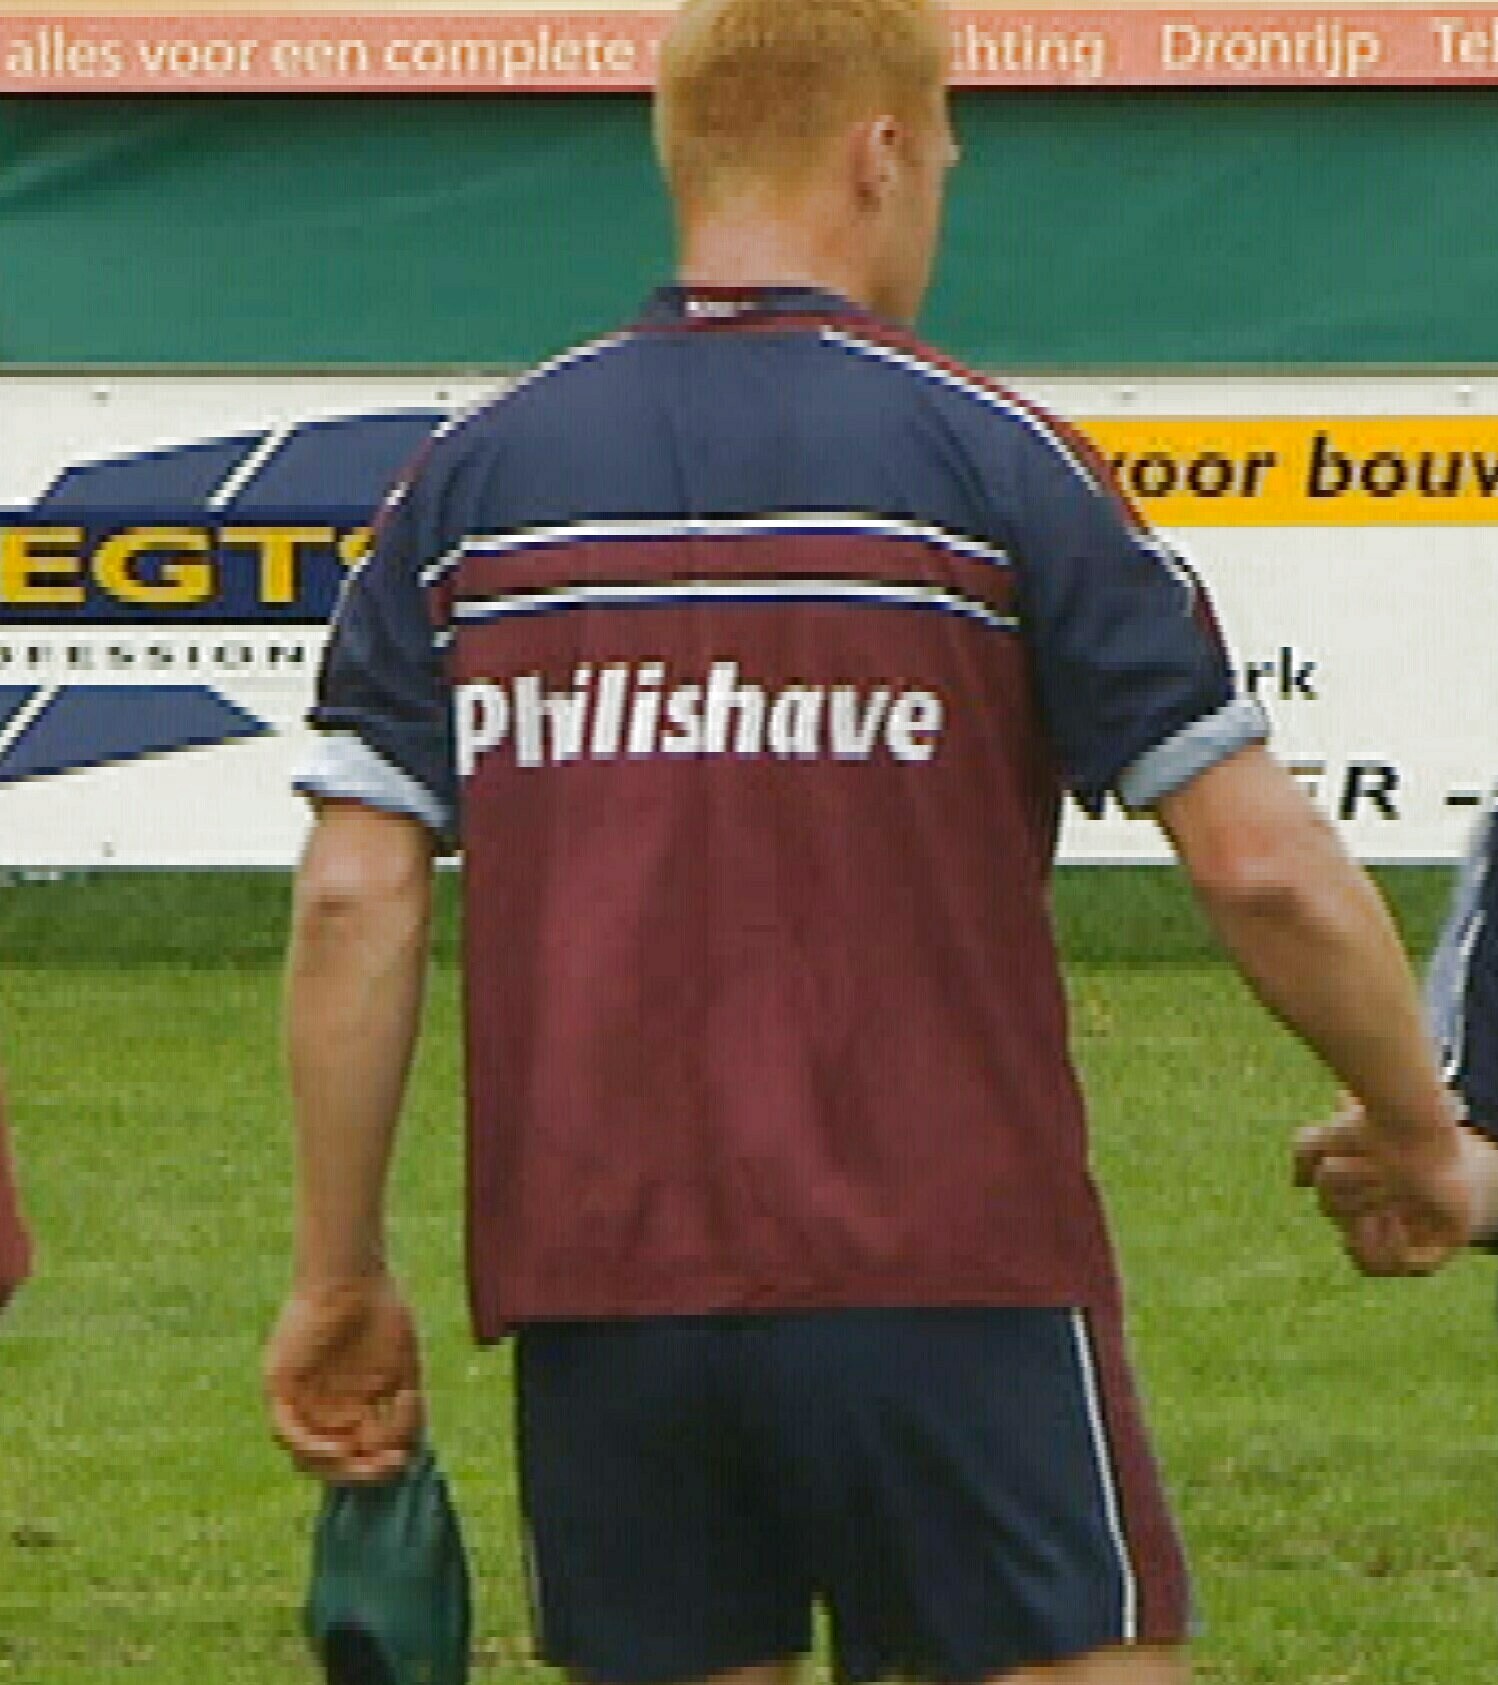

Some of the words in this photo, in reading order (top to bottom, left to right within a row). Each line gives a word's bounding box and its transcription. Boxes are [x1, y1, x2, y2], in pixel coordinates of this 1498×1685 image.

[4, 24, 122, 77] alles
[139, 38, 258, 74] voor
[271, 38, 367, 74] een
[383, 24, 636, 83] complete
[1160, 22, 1382, 78] Dronrijp
[1245, 647, 1319, 694] rk
[455, 660, 945, 776] Philishave
